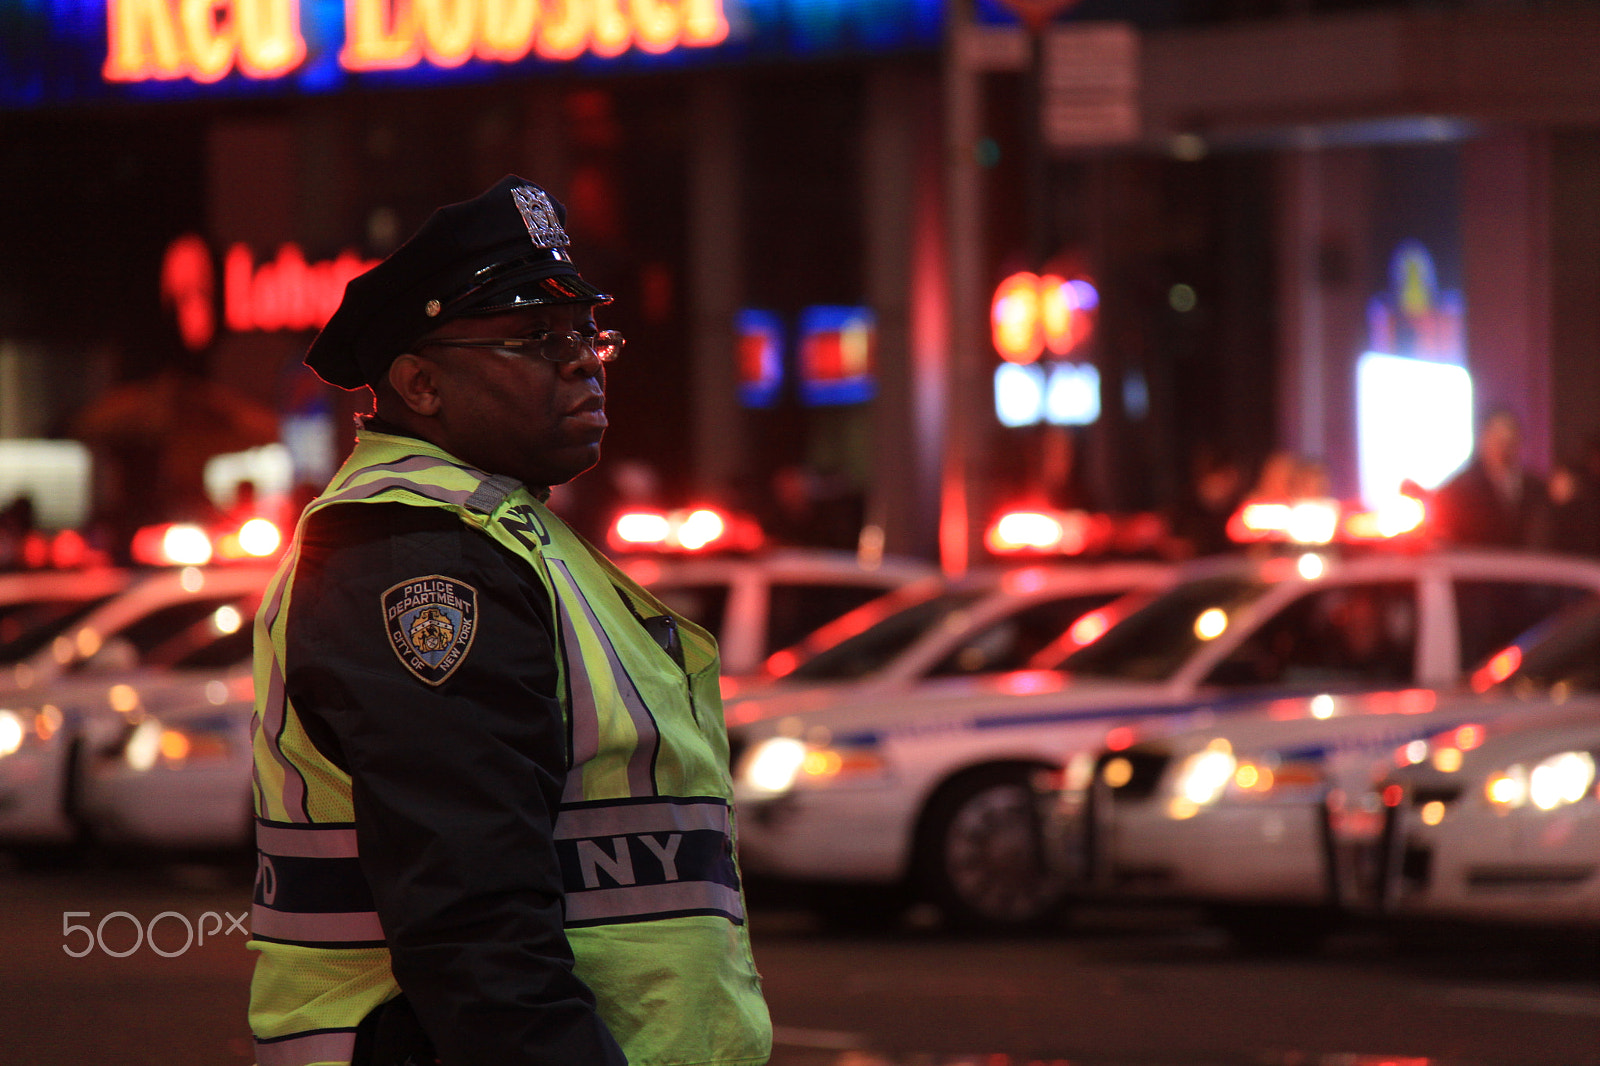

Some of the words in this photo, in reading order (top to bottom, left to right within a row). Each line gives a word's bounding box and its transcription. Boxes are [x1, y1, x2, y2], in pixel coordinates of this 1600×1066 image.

[388, 592, 472, 621] DEPARTMENT
[404, 581, 454, 598] POLICE
[393, 630, 412, 656] CITY
[410, 656, 426, 671] OF
[439, 648, 461, 672] NEW
[456, 617, 473, 646] YORK
[576, 833, 683, 889] NY
